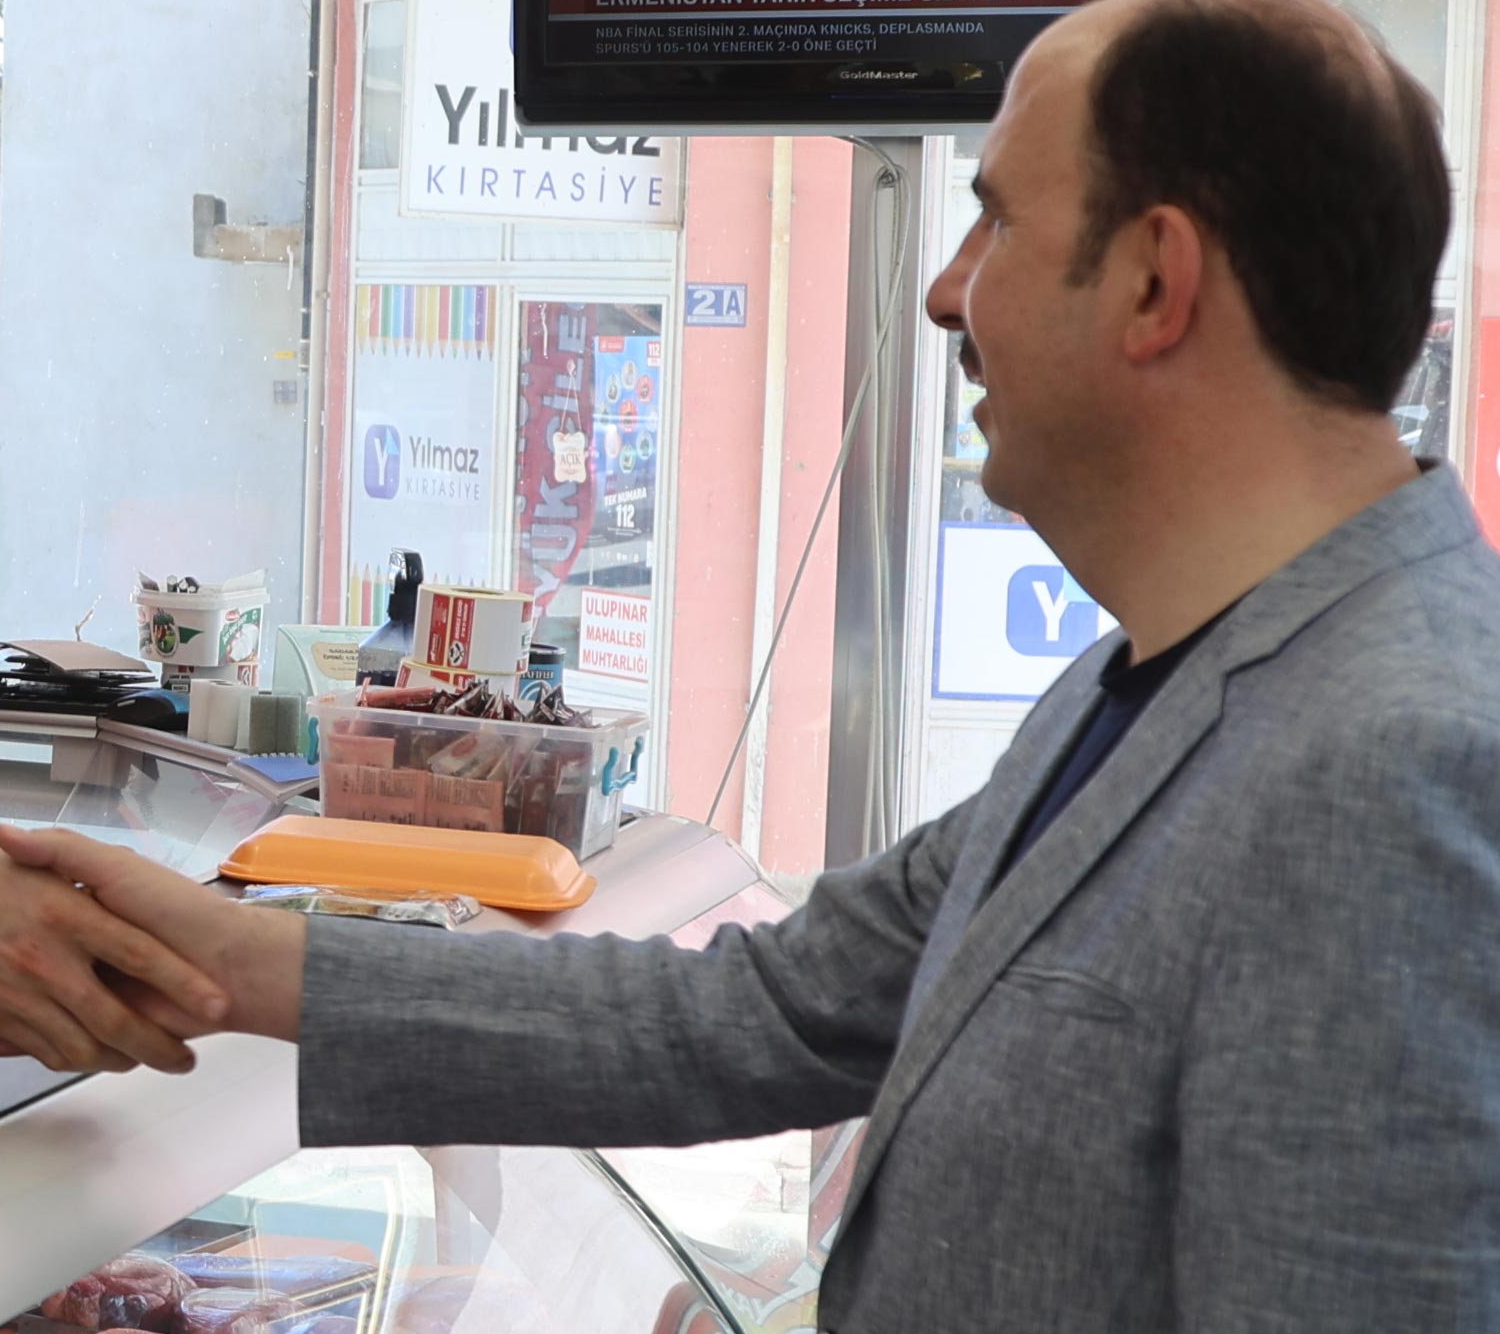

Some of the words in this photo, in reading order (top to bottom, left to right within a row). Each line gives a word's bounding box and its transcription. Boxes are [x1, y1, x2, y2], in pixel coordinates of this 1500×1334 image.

[594, 26, 624, 39] NBA
[626, 24, 664, 38] FİNAL
[667, 23, 735, 37] SERİSİNİN
[737, 24, 750, 36] 2.
[752, 23, 818, 38] MAÇINDA
[820, 23, 876, 37] KNICKS,
[878, 21, 985, 35] DEPLASMANDA
[594, 39, 652, 54] SPURS'Ü
[655, 41, 710, 53] 105-104
[712, 41, 775, 53] YENEREK
[778, 40, 801, 53] 2-0
[803, 37, 833, 53] ÖNE
[835, 38, 878, 56] GEÇTİ
[838, 68, 919, 82] GoldMaster
[434, 83, 662, 159] Yıl
[426, 163, 664, 207] KIRTASİYE
[692, 288, 717, 317] 2
[725, 288, 741, 318] A
[408, 434, 480, 476] Yılmaz
[559, 451, 582, 469] AÇIK
[404, 473, 481, 501] KIRTASİYE
[615, 504, 636, 528] 112
[585, 595, 648, 624] ULUPINAR
[584, 625, 647, 649] MAHALLESİ
[582, 647, 649, 675] MUHTARLIĞI
